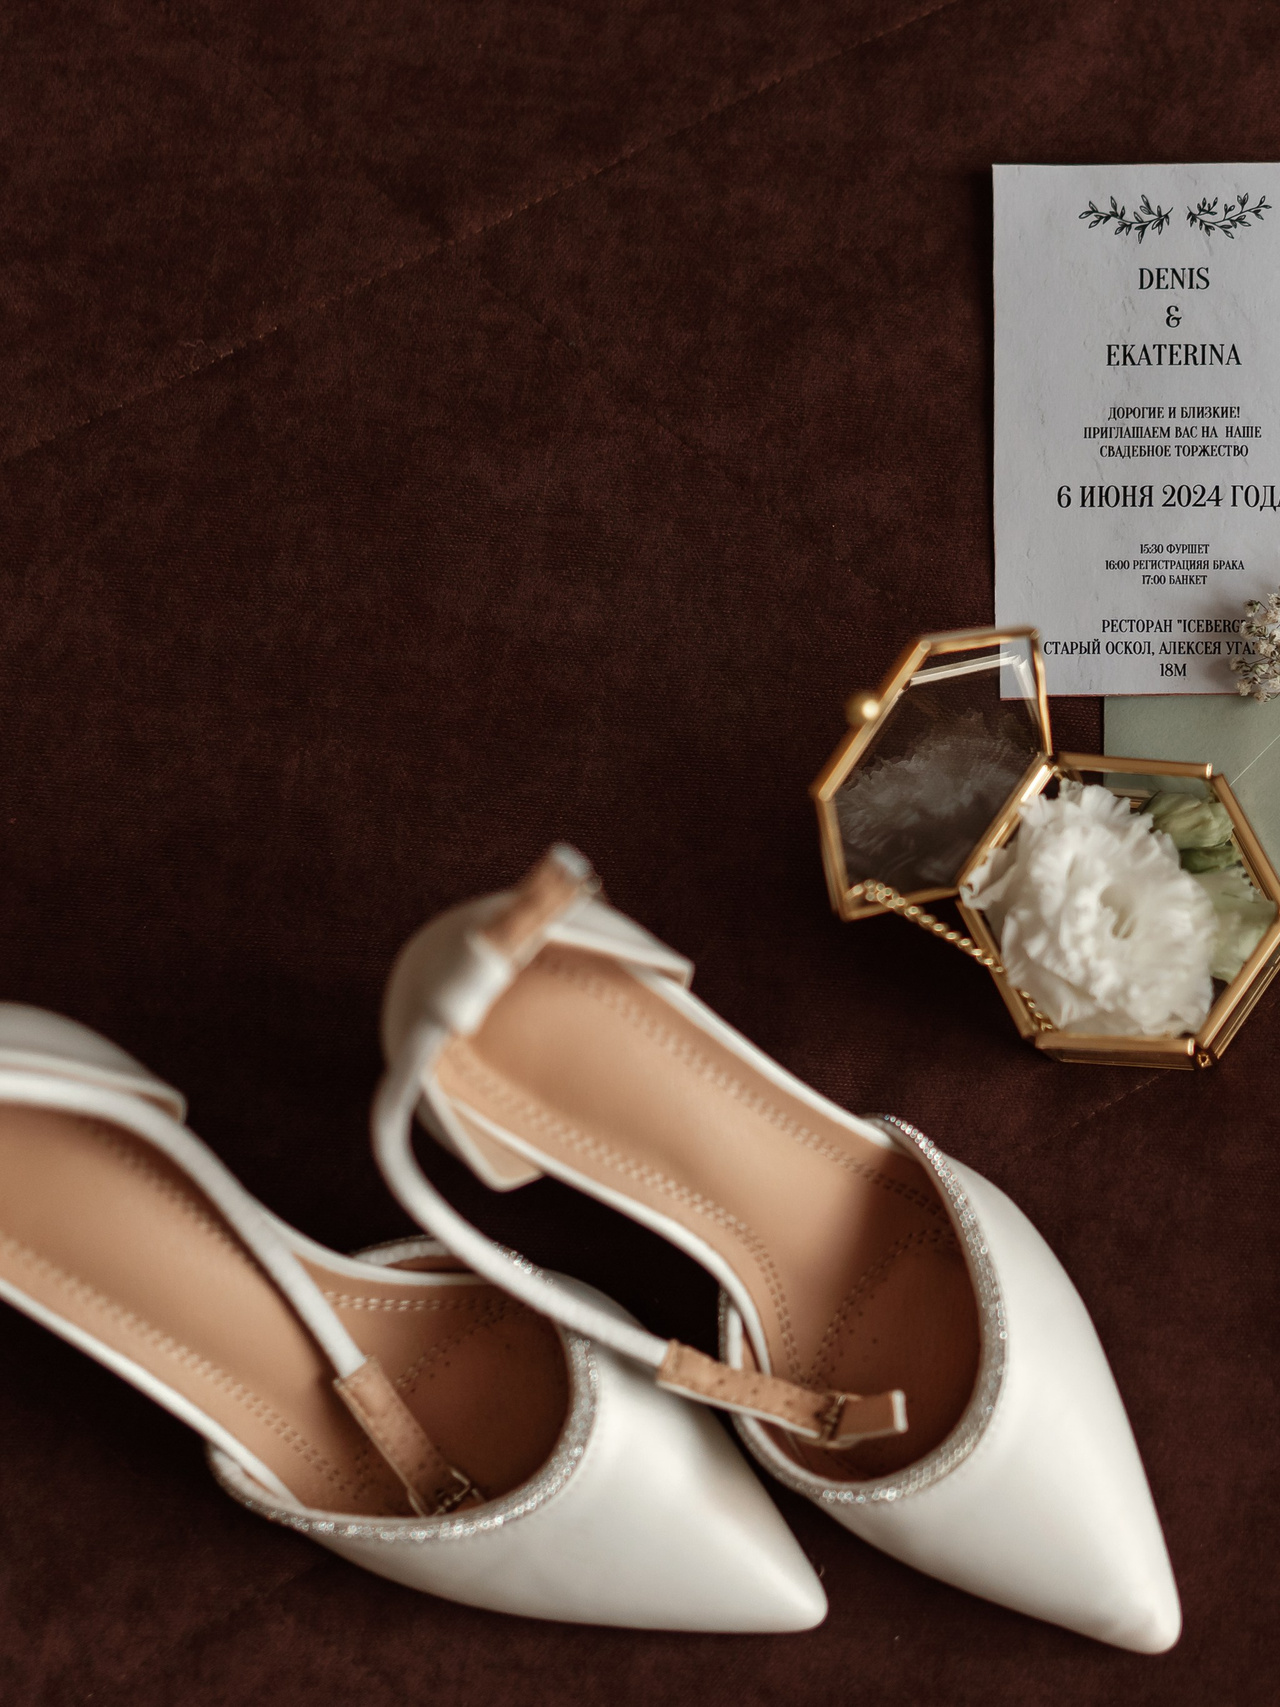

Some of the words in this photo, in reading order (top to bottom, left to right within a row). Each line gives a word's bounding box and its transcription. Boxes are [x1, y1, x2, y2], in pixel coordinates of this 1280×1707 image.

[1138, 267, 1210, 290] DENIS
[1165, 305, 1183, 328] &
[1106, 343, 1242, 366] EKATERINA
[1108, 406, 1165, 421] ДОРОГИЕ
[1168, 406, 1177, 419] И
[1180, 406, 1241, 419] БЛИЗКИЕ!
[1083, 426, 1171, 439] ПРИГЛАШАЕМ
[1174, 426, 1198, 439] ВАС
[1201, 426, 1219, 439] НА
[1225, 425, 1262, 438] НАШЕ
[1099, 444, 1172, 459] СВАДЕБНОЕ
[1174, 444, 1249, 458] ТОРЖЕСТВО
[1056, 485, 1072, 508] 6
[1079, 485, 1154, 508] ИЮНЯ
[1161, 484, 1224, 508] 2024
[1139, 543, 1164, 554] 15:30
[1166, 543, 1210, 554] ФУРШЕТ
[1105, 559, 1130, 571] 16:00
[1132, 559, 1210, 571] РЕГИСТРАЦИЯЯ
[1212, 559, 1245, 571] БРАКА
[1142, 574, 1166, 585] 17:00
[1169, 574, 1208, 585] БАНКЕТ
[1101, 619, 1173, 633] РЕСТОРАН
[1043, 638, 1101, 655] СТАРЫЙ
[1105, 640, 1155, 656] ОСКОЛ,
[1158, 640, 1222, 655] АЛЕКСЕЯ
